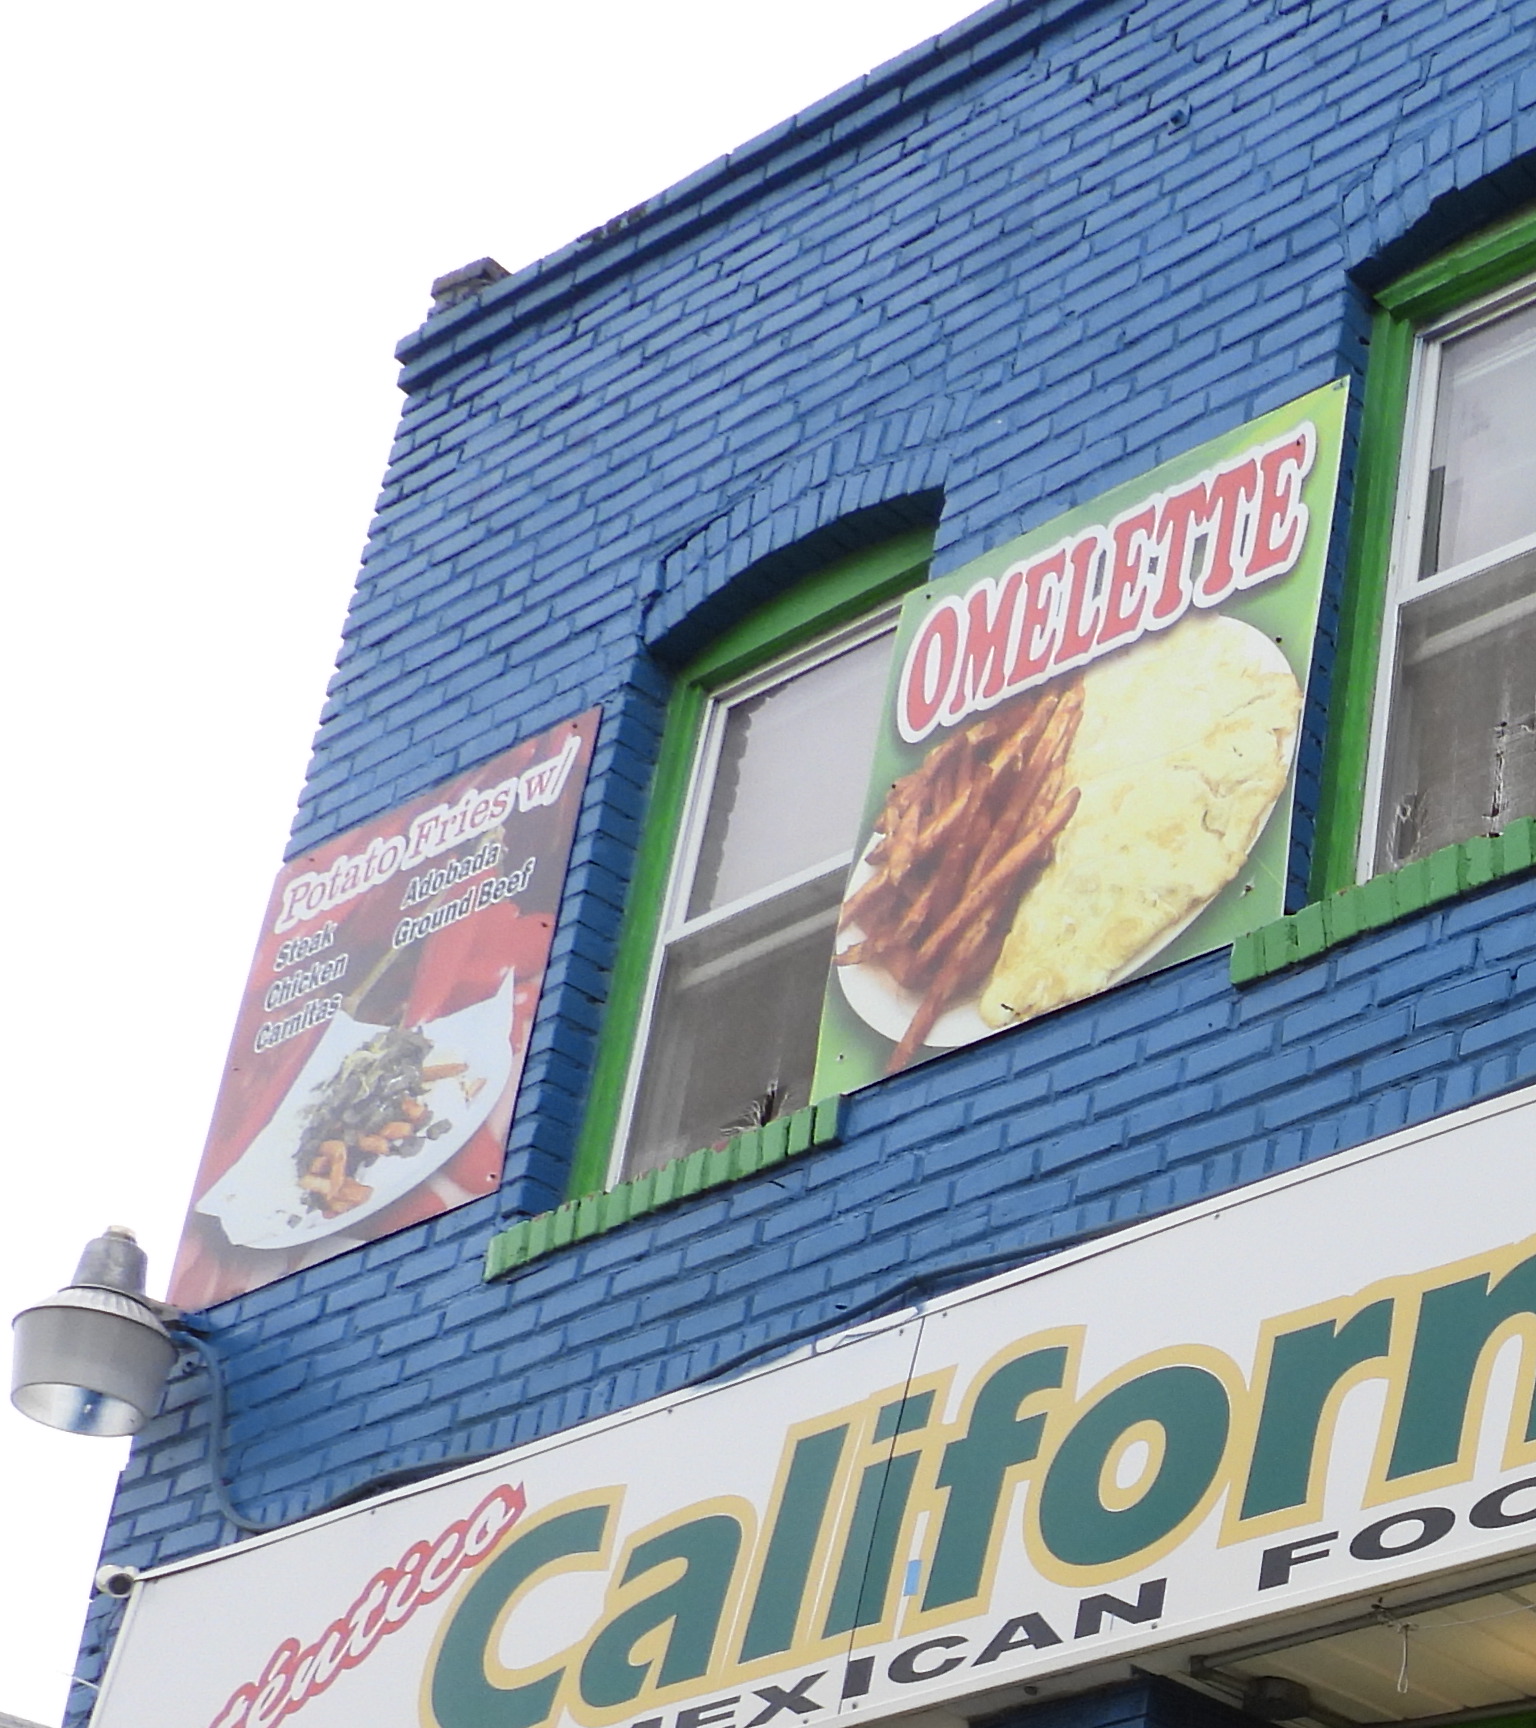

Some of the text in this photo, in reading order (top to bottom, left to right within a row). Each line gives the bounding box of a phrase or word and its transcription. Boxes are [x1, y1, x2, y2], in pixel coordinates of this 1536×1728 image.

[898, 421, 1316, 744] OMELETTE
[275, 733, 581, 934] Potato Fries w/
[393, 857, 536, 949] Ground Beef
[401, 843, 500, 909] Adobada
[273, 920, 338, 971] Steak
[264, 954, 348, 1012] Chicken
[255, 994, 342, 1053] Carnitas
